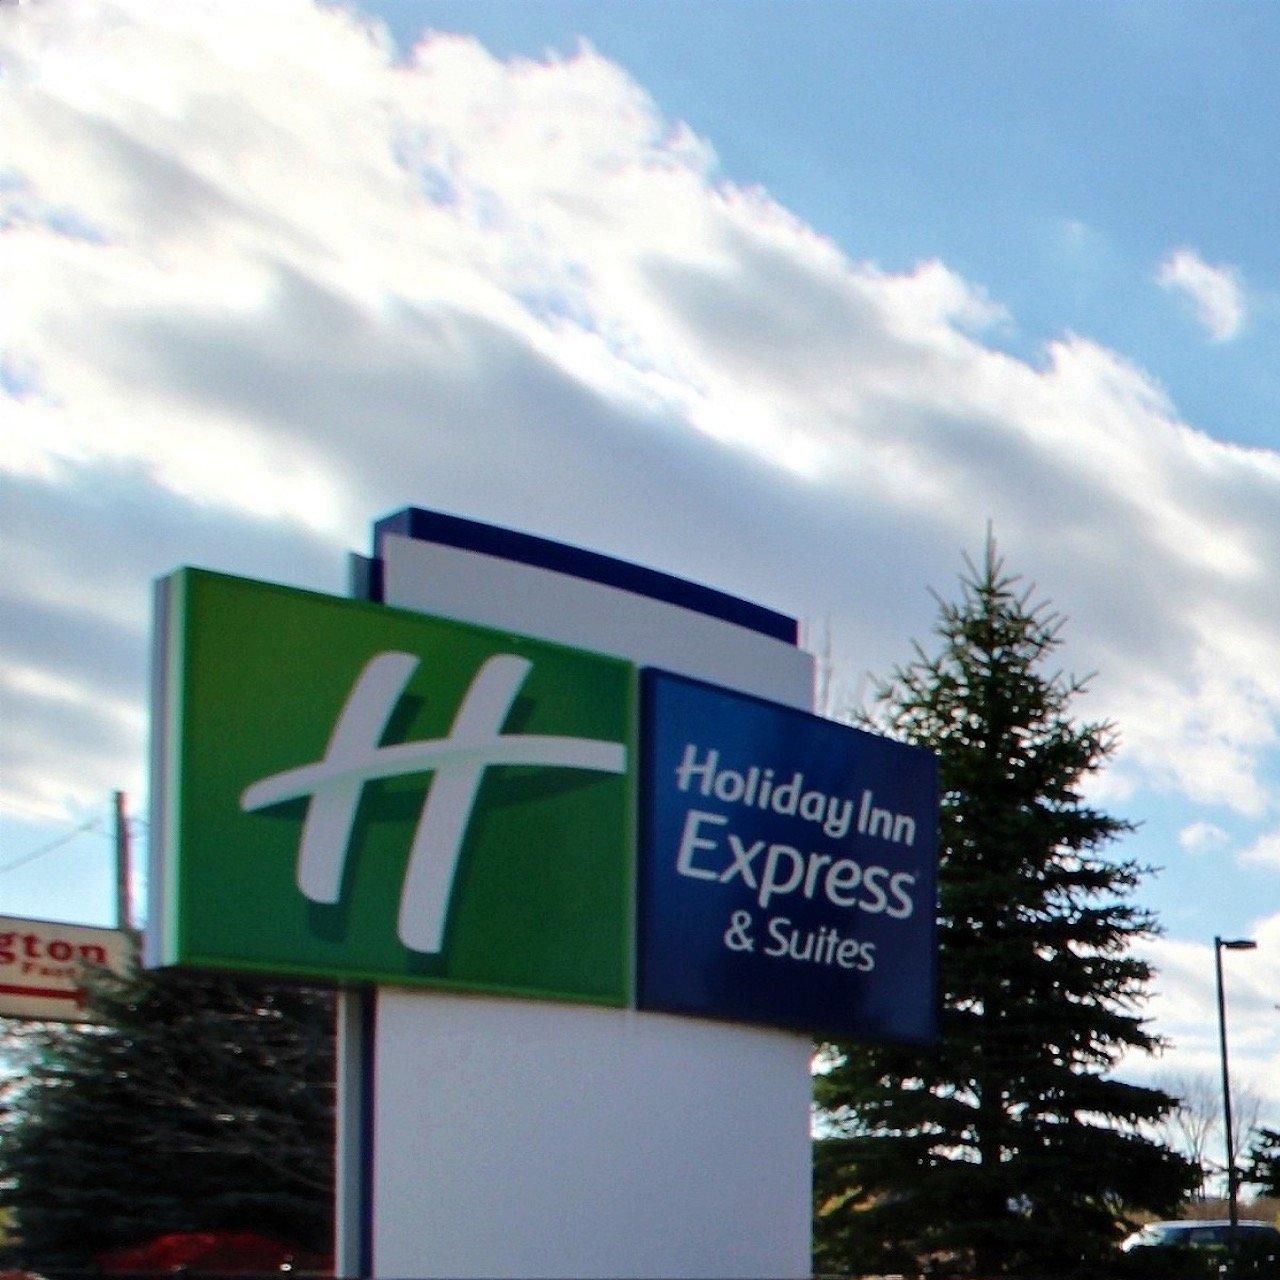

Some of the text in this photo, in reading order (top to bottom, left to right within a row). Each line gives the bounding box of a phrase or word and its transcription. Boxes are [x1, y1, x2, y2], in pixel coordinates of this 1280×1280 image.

[675, 744, 916, 846] Holiday Inn
[676, 809, 916, 920] Express
[723, 910, 877, 973] & Suites
